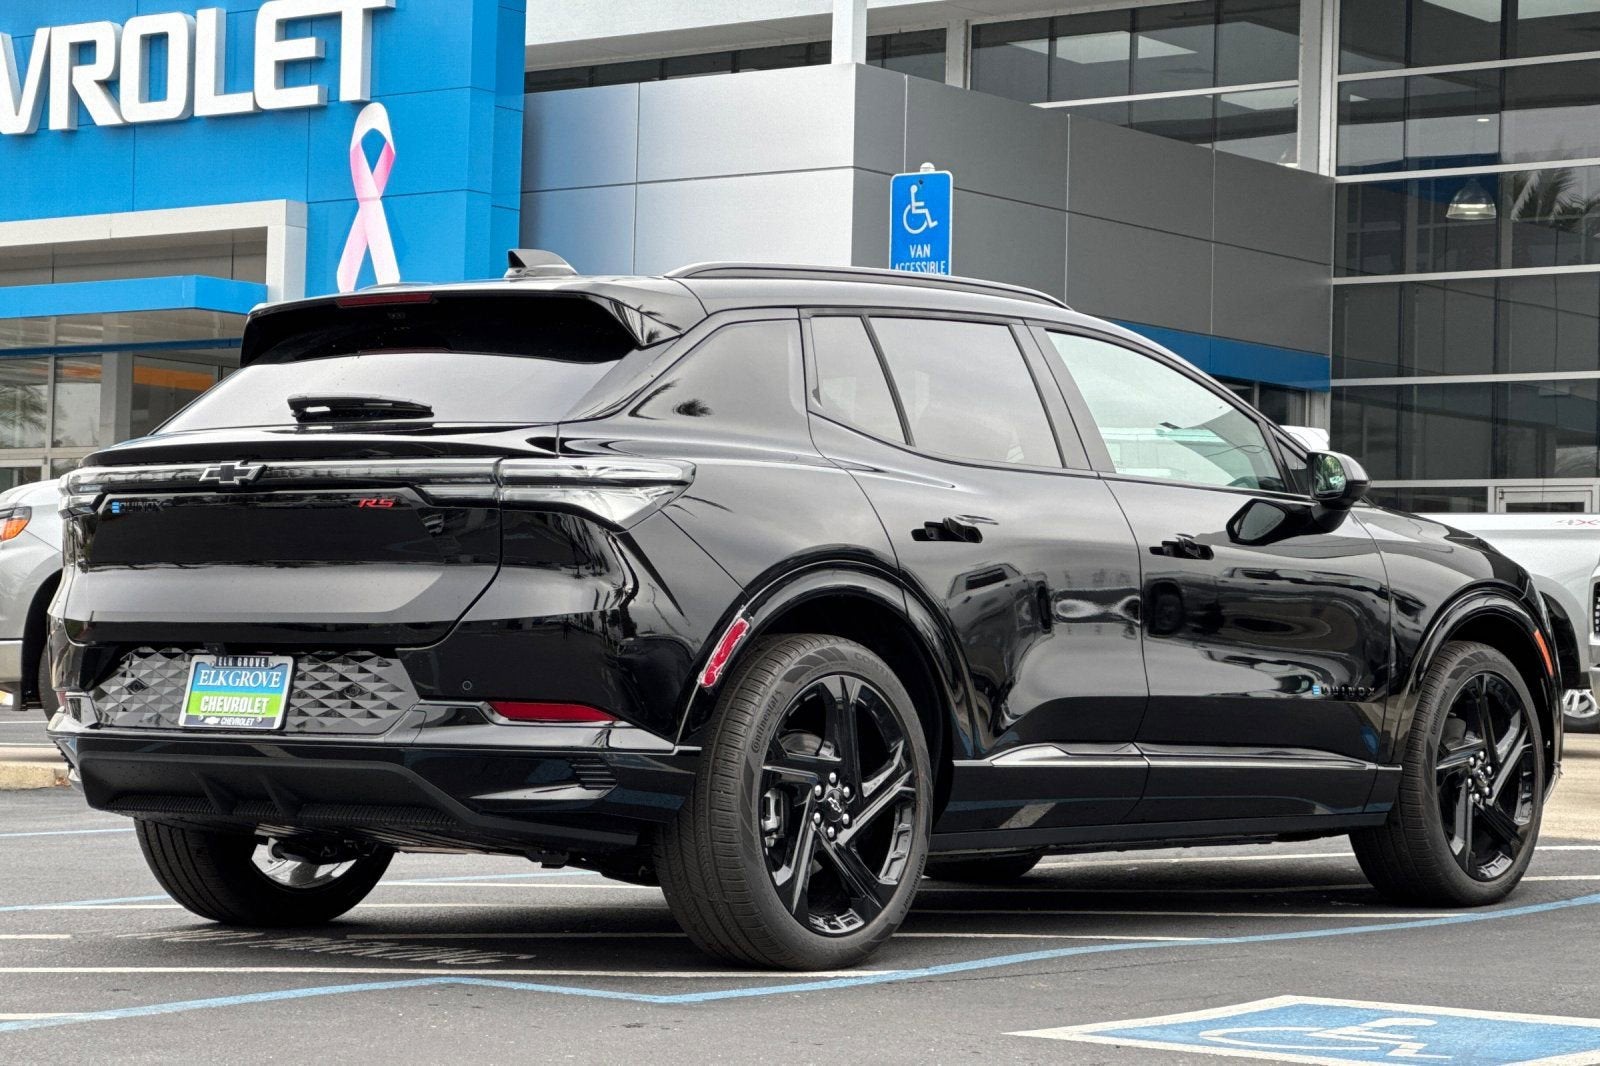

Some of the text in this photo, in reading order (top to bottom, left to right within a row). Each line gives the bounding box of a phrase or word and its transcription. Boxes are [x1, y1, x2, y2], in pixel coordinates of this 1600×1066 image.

[909, 244, 931, 258] VAN
[358, 498, 394, 508] RS
[218, 657, 265, 668] ELK GROVE
[197, 669, 282, 688] ELK GROVE
[200, 696, 270, 714] CHEVROLET
[220, 717, 255, 726] CHEVROLET
